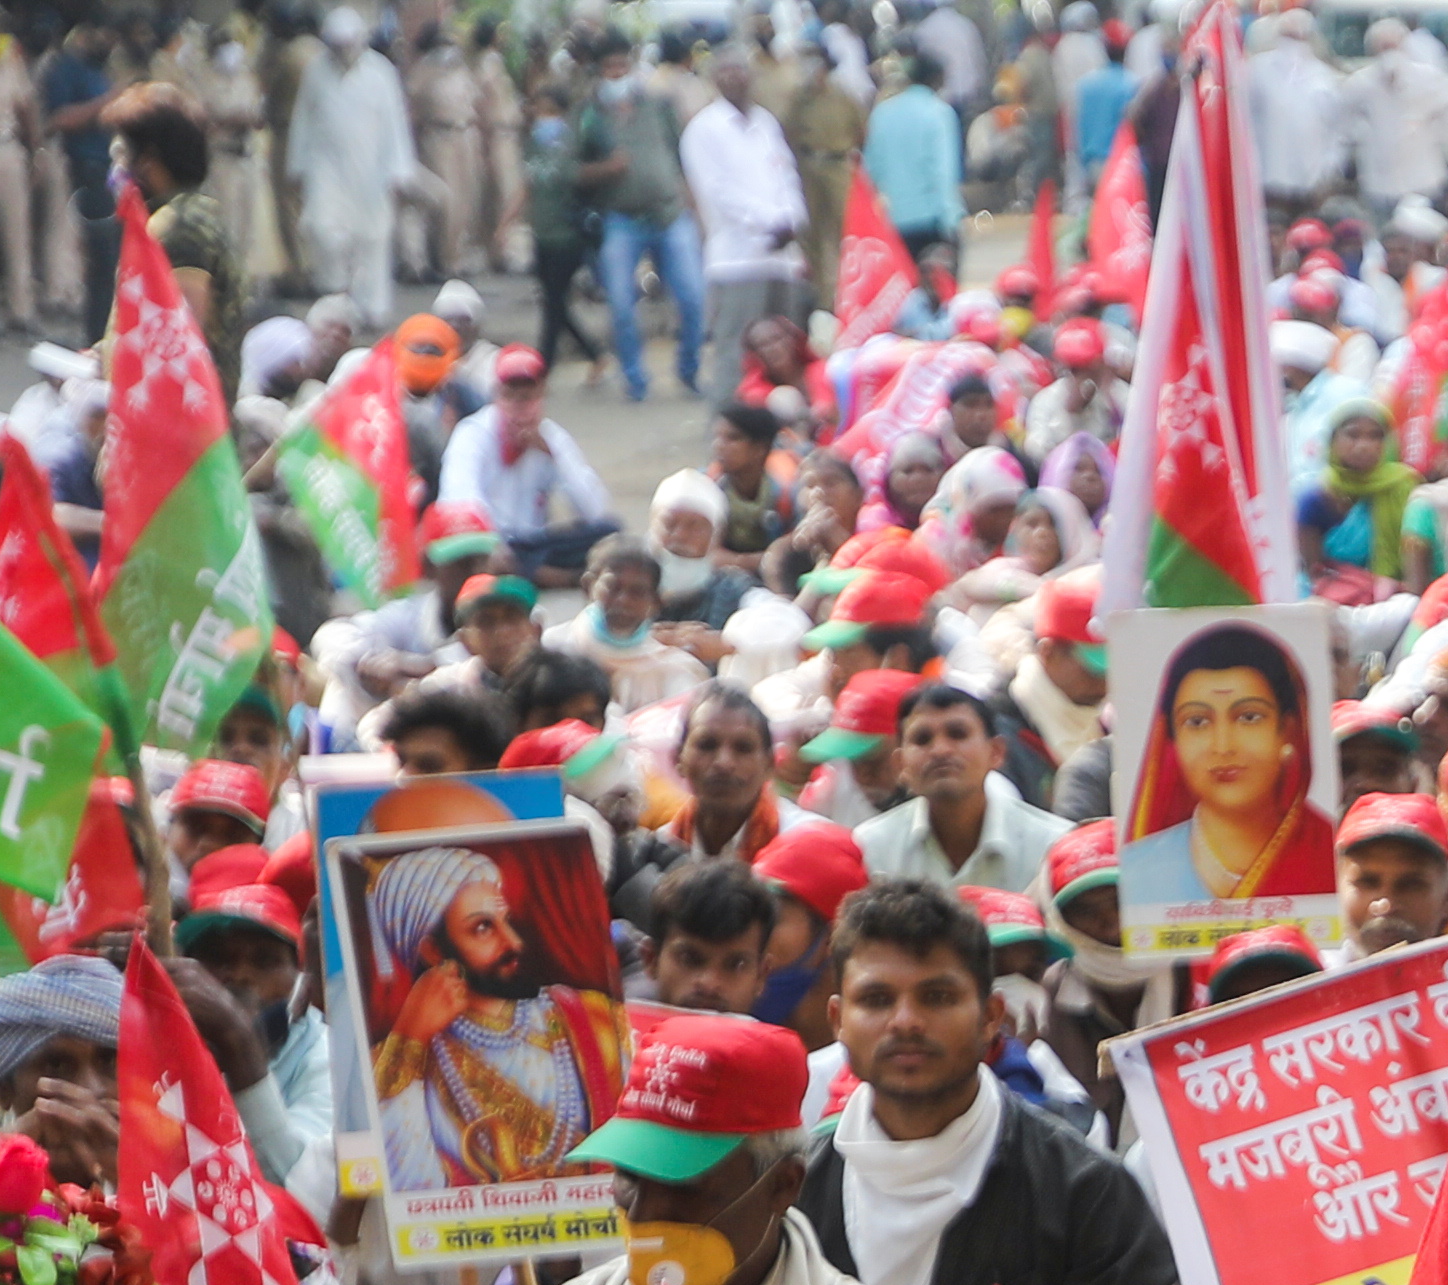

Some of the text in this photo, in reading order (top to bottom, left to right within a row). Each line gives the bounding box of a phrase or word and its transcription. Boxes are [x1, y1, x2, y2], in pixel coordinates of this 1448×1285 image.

[1173, 1036, 1268, 1112] केंद्र
[1263, 991, 1430, 1086] सरकार
[1199, 1085, 1364, 1190] मजबूरी
[444, 1209, 619, 1250] लोक संघर्ष मोर्चा
[1310, 1160, 1410, 1242] और
